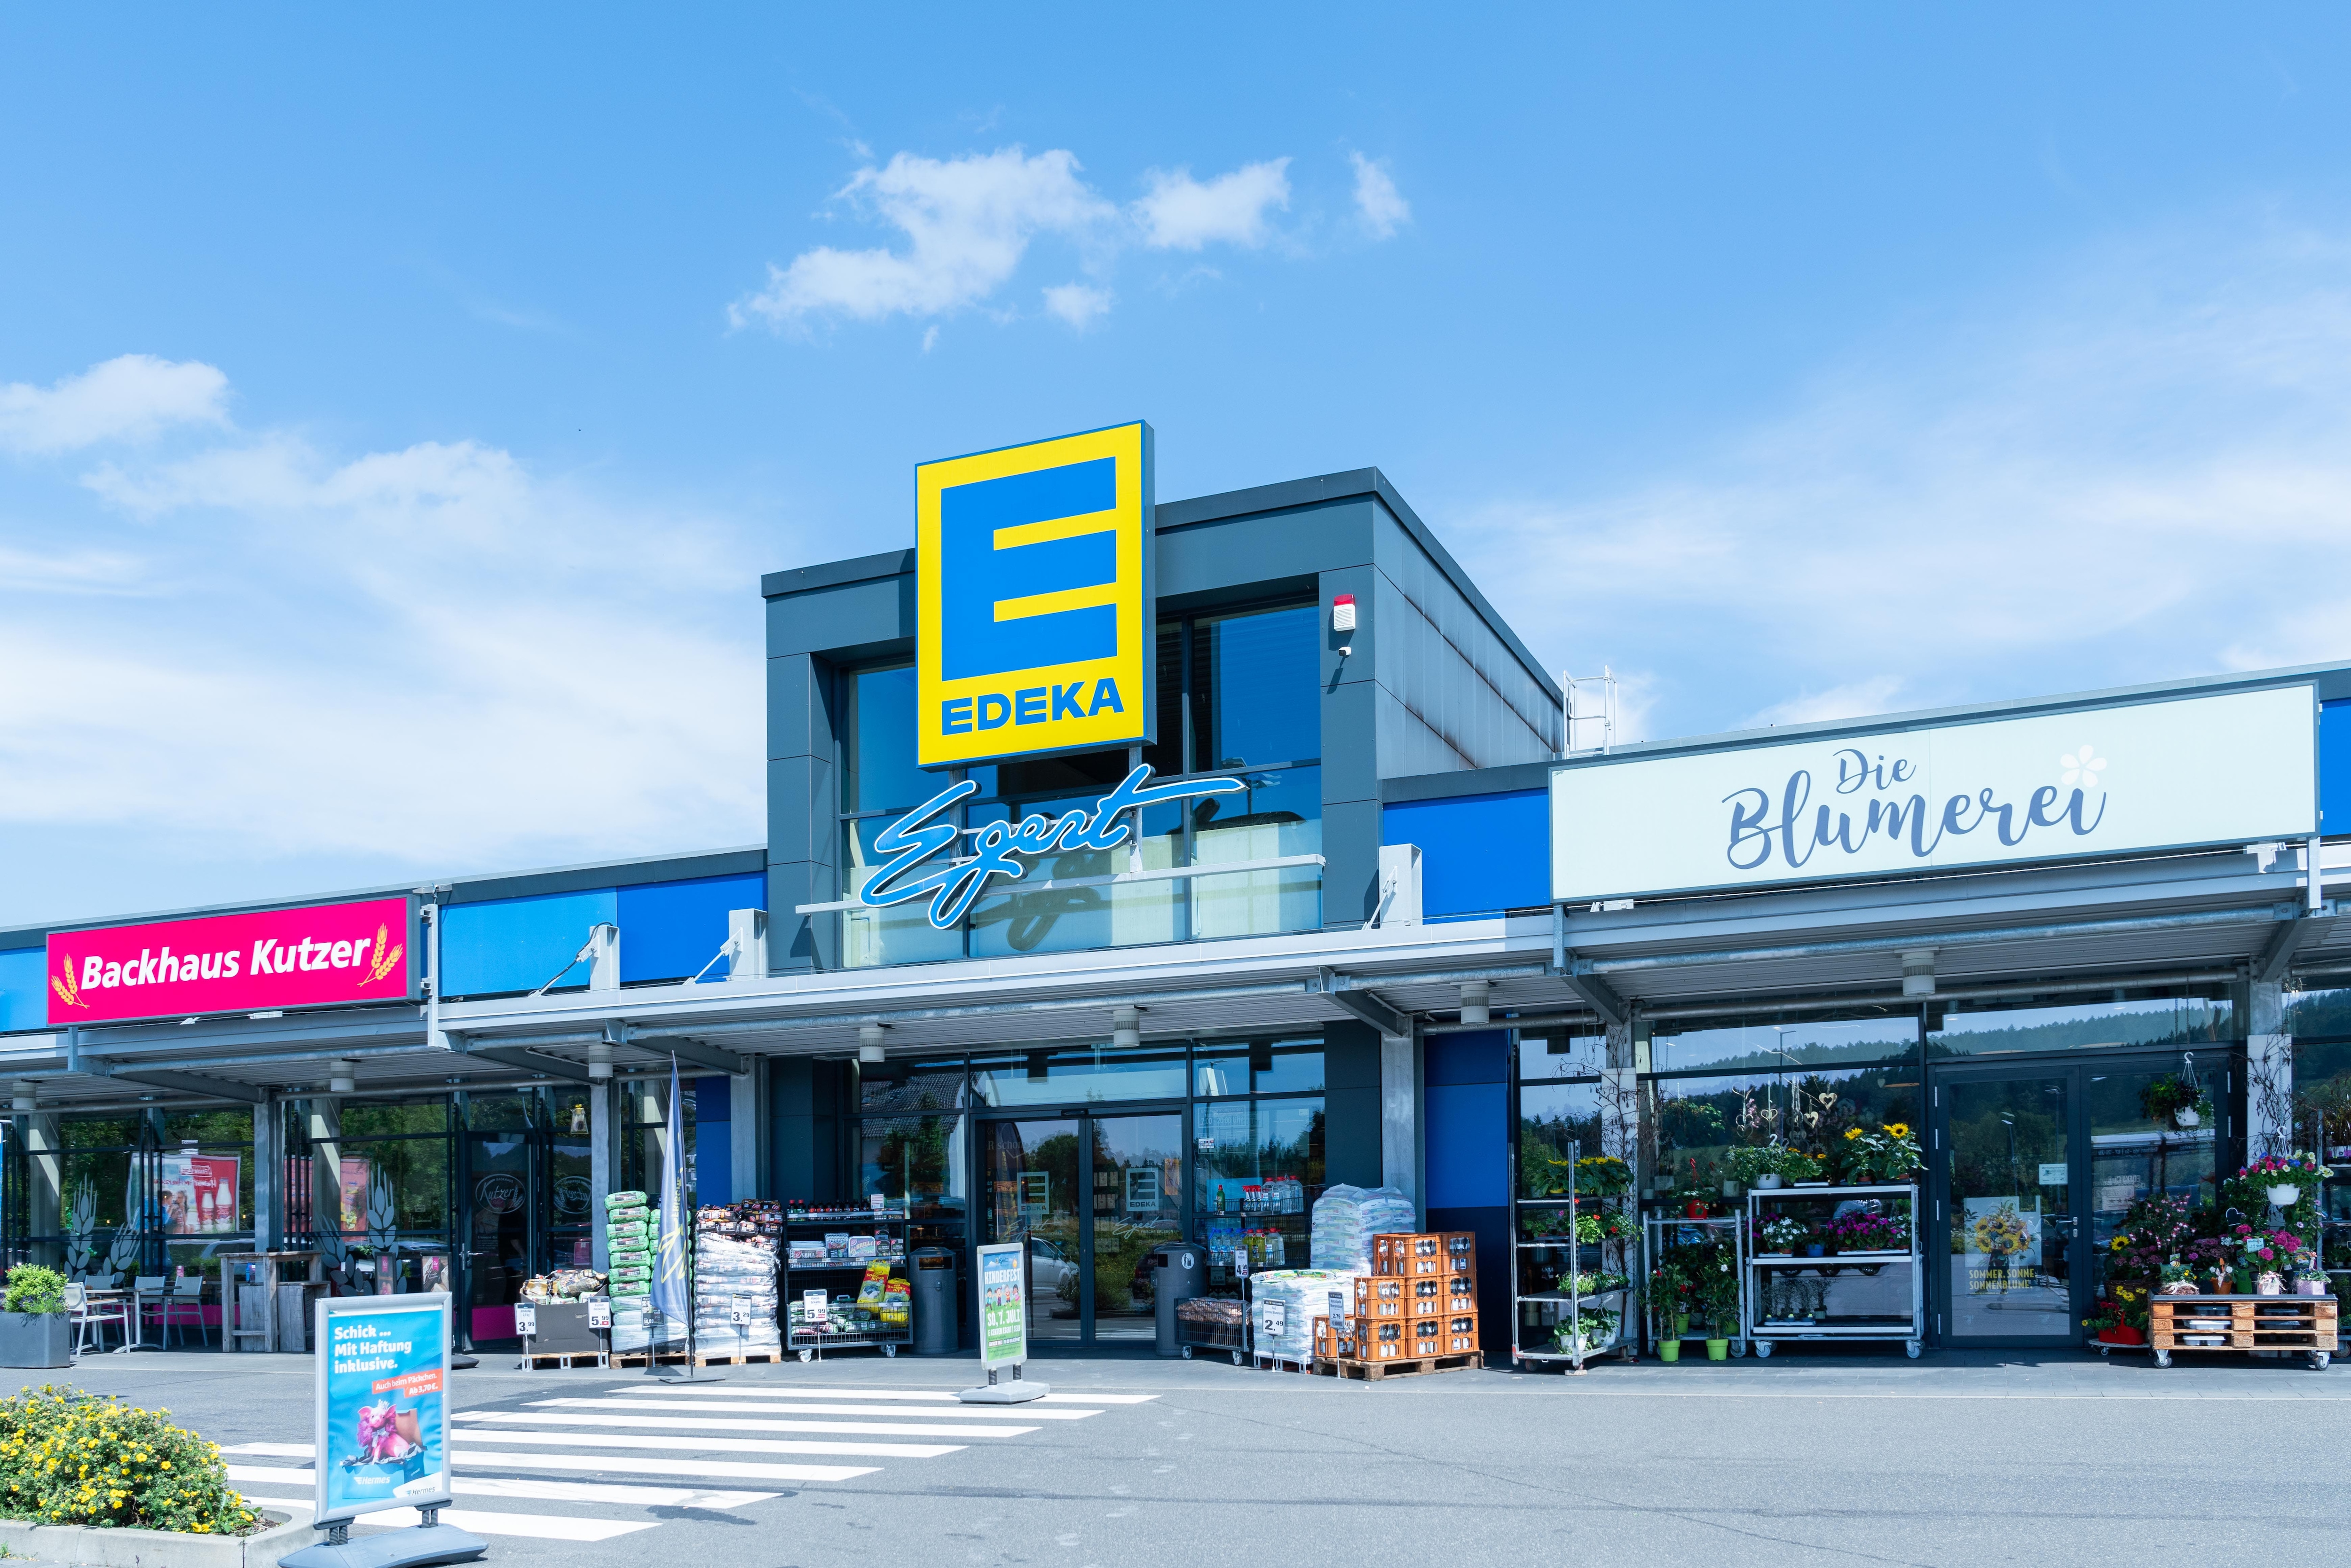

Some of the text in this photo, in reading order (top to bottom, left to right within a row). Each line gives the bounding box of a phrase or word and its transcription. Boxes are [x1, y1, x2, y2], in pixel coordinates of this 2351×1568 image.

[941, 678, 1124, 736] EDEKA
[1833, 749, 1916, 794] Die
[1721, 770, 2106, 870] Blumerei
[859, 763, 1249, 930] Egert
[81, 936, 371, 990] Backhaus Kutzer
[479, 1179, 514, 1209] Kutzer
[1004, 1219, 1062, 1241] Egert
[1112, 1216, 1174, 1239] Egert
[985, 1268, 1021, 1284] KINDERFEST
[1969, 1269, 2005, 1279] SOMMER.
[1969, 1279, 2032, 1290] SONNENBLUME.
[592, 1316, 609, 1325] 5.99
[733, 1312, 749, 1322] 3.29
[988, 1309, 1020, 1327] SO, 7. JULI
[1265, 1319, 1284, 1331] 2.49
[334, 1324, 377, 1339] Schick
[519, 1322, 534, 1332] 3.99
[991, 1327, 1002, 1336] CENTER
[334, 1340, 412, 1356] Mit Haftung
[334, 1356, 398, 1374] inklusive.
[376, 1381, 391, 1390] Auch
[408, 1373, 437, 1383] Päckchen.
[412, 1487, 435, 1496] Hermes
